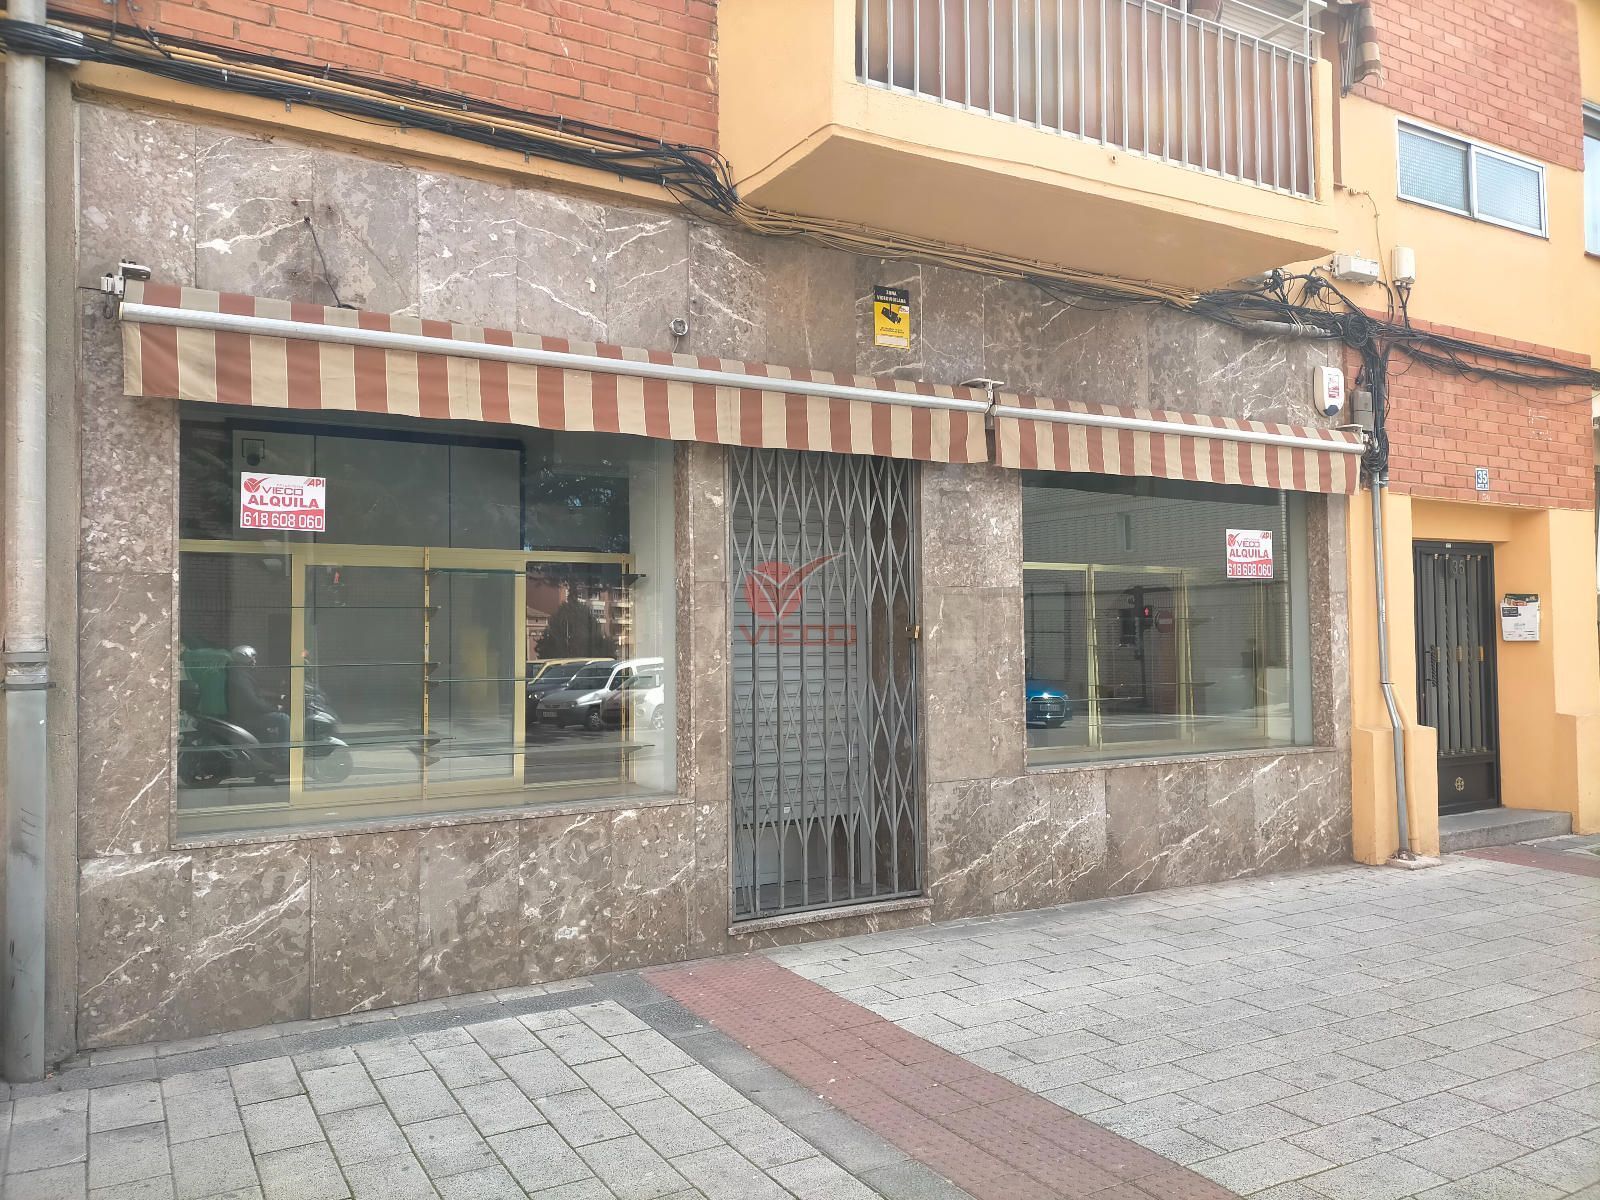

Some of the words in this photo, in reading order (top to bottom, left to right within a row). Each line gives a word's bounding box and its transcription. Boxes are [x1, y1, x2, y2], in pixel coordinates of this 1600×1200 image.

[307, 478, 325, 488] API
[1477, 470, 1488, 484] 35
[262, 486, 304, 497] VIECO
[248, 495, 320, 509] ALQUILA
[243, 511, 269, 527] 618
[271, 513, 296, 528] 608
[298, 514, 323, 529] 060
[1229, 548, 1270, 559] ALQUILA
[1228, 563, 1242, 576] 618
[1243, 563, 1257, 576] 608
[1258, 564, 1272, 577] 060
